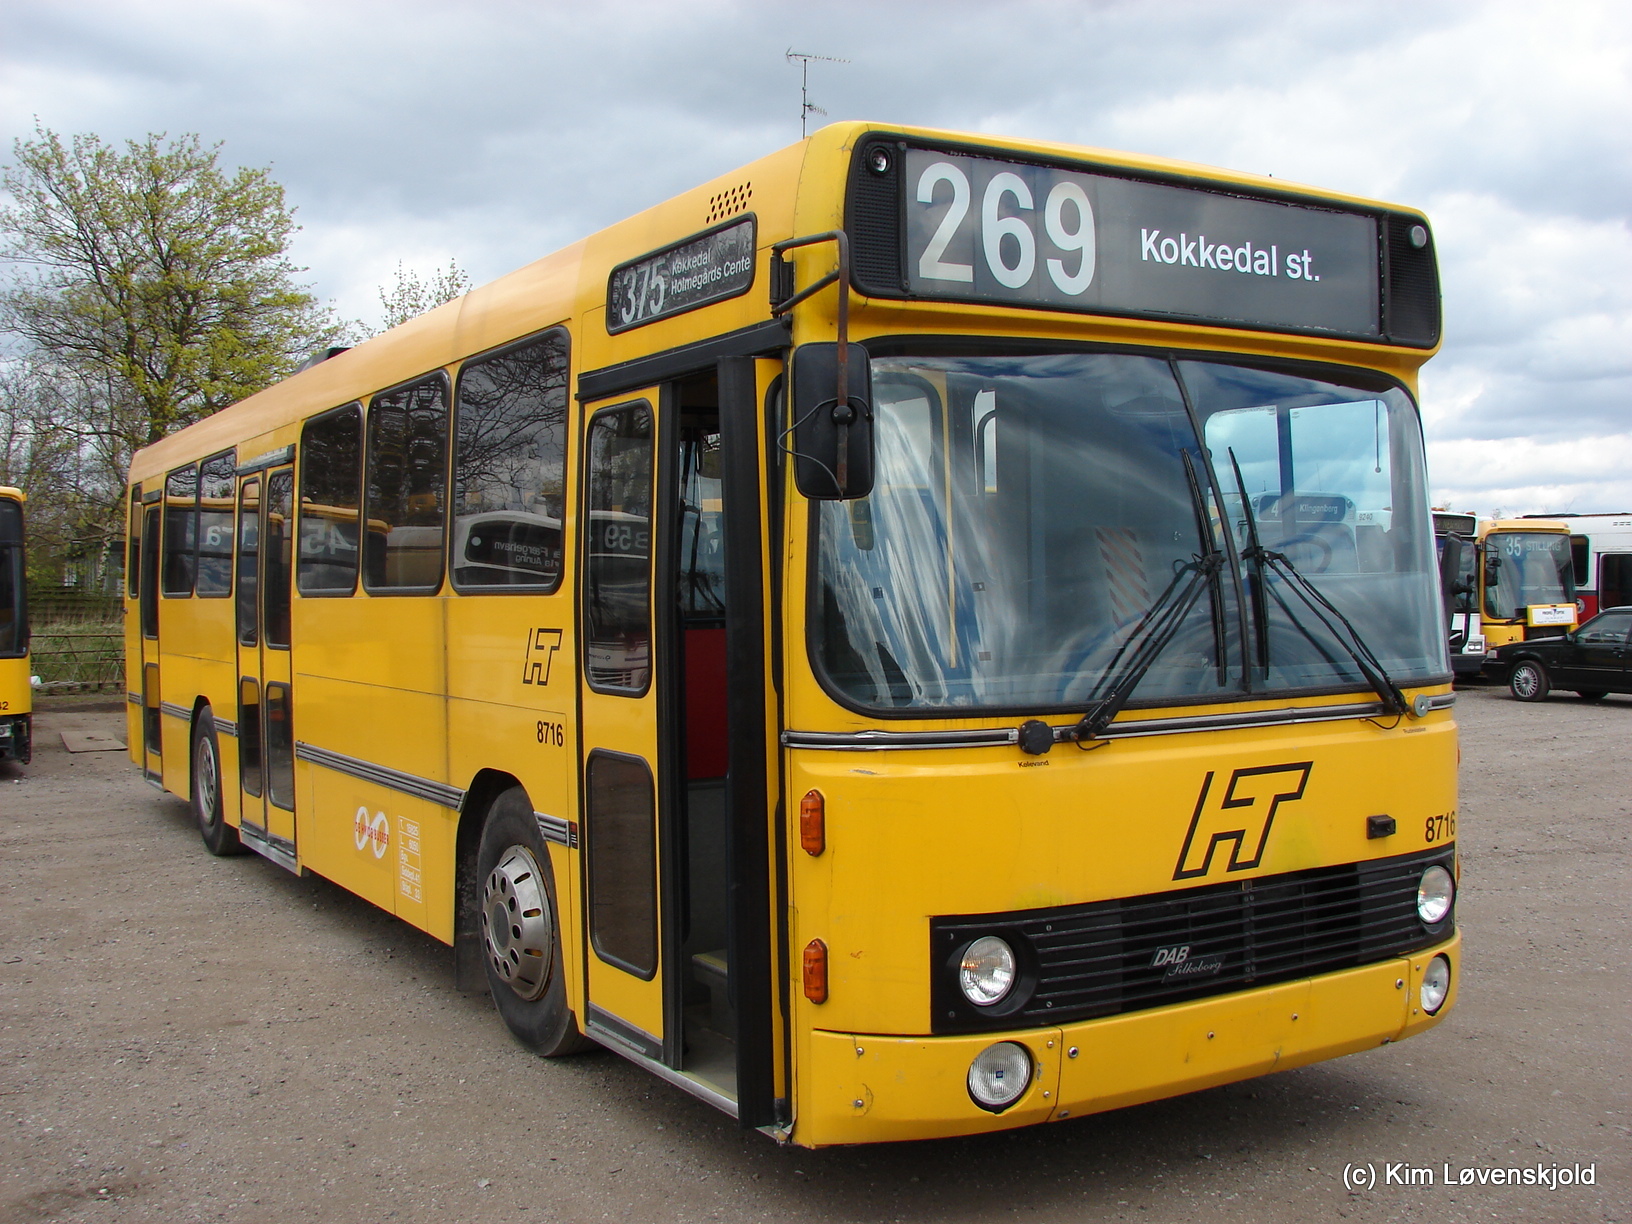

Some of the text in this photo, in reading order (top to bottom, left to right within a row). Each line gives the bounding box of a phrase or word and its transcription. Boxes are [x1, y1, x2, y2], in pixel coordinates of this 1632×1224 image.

[915, 161, 1096, 296] 269
[672, 247, 711, 276] Kokkedal
[1140, 228, 1320, 282] Kokkedal st.
[621, 257, 666, 324] 375
[671, 265, 722, 296] Holmegårds
[1506, 536, 1521, 557] 35
[536, 720, 564, 748] 8716
[1425, 810, 1456, 843] 8716
[1152, 945, 1190, 967] DAB
